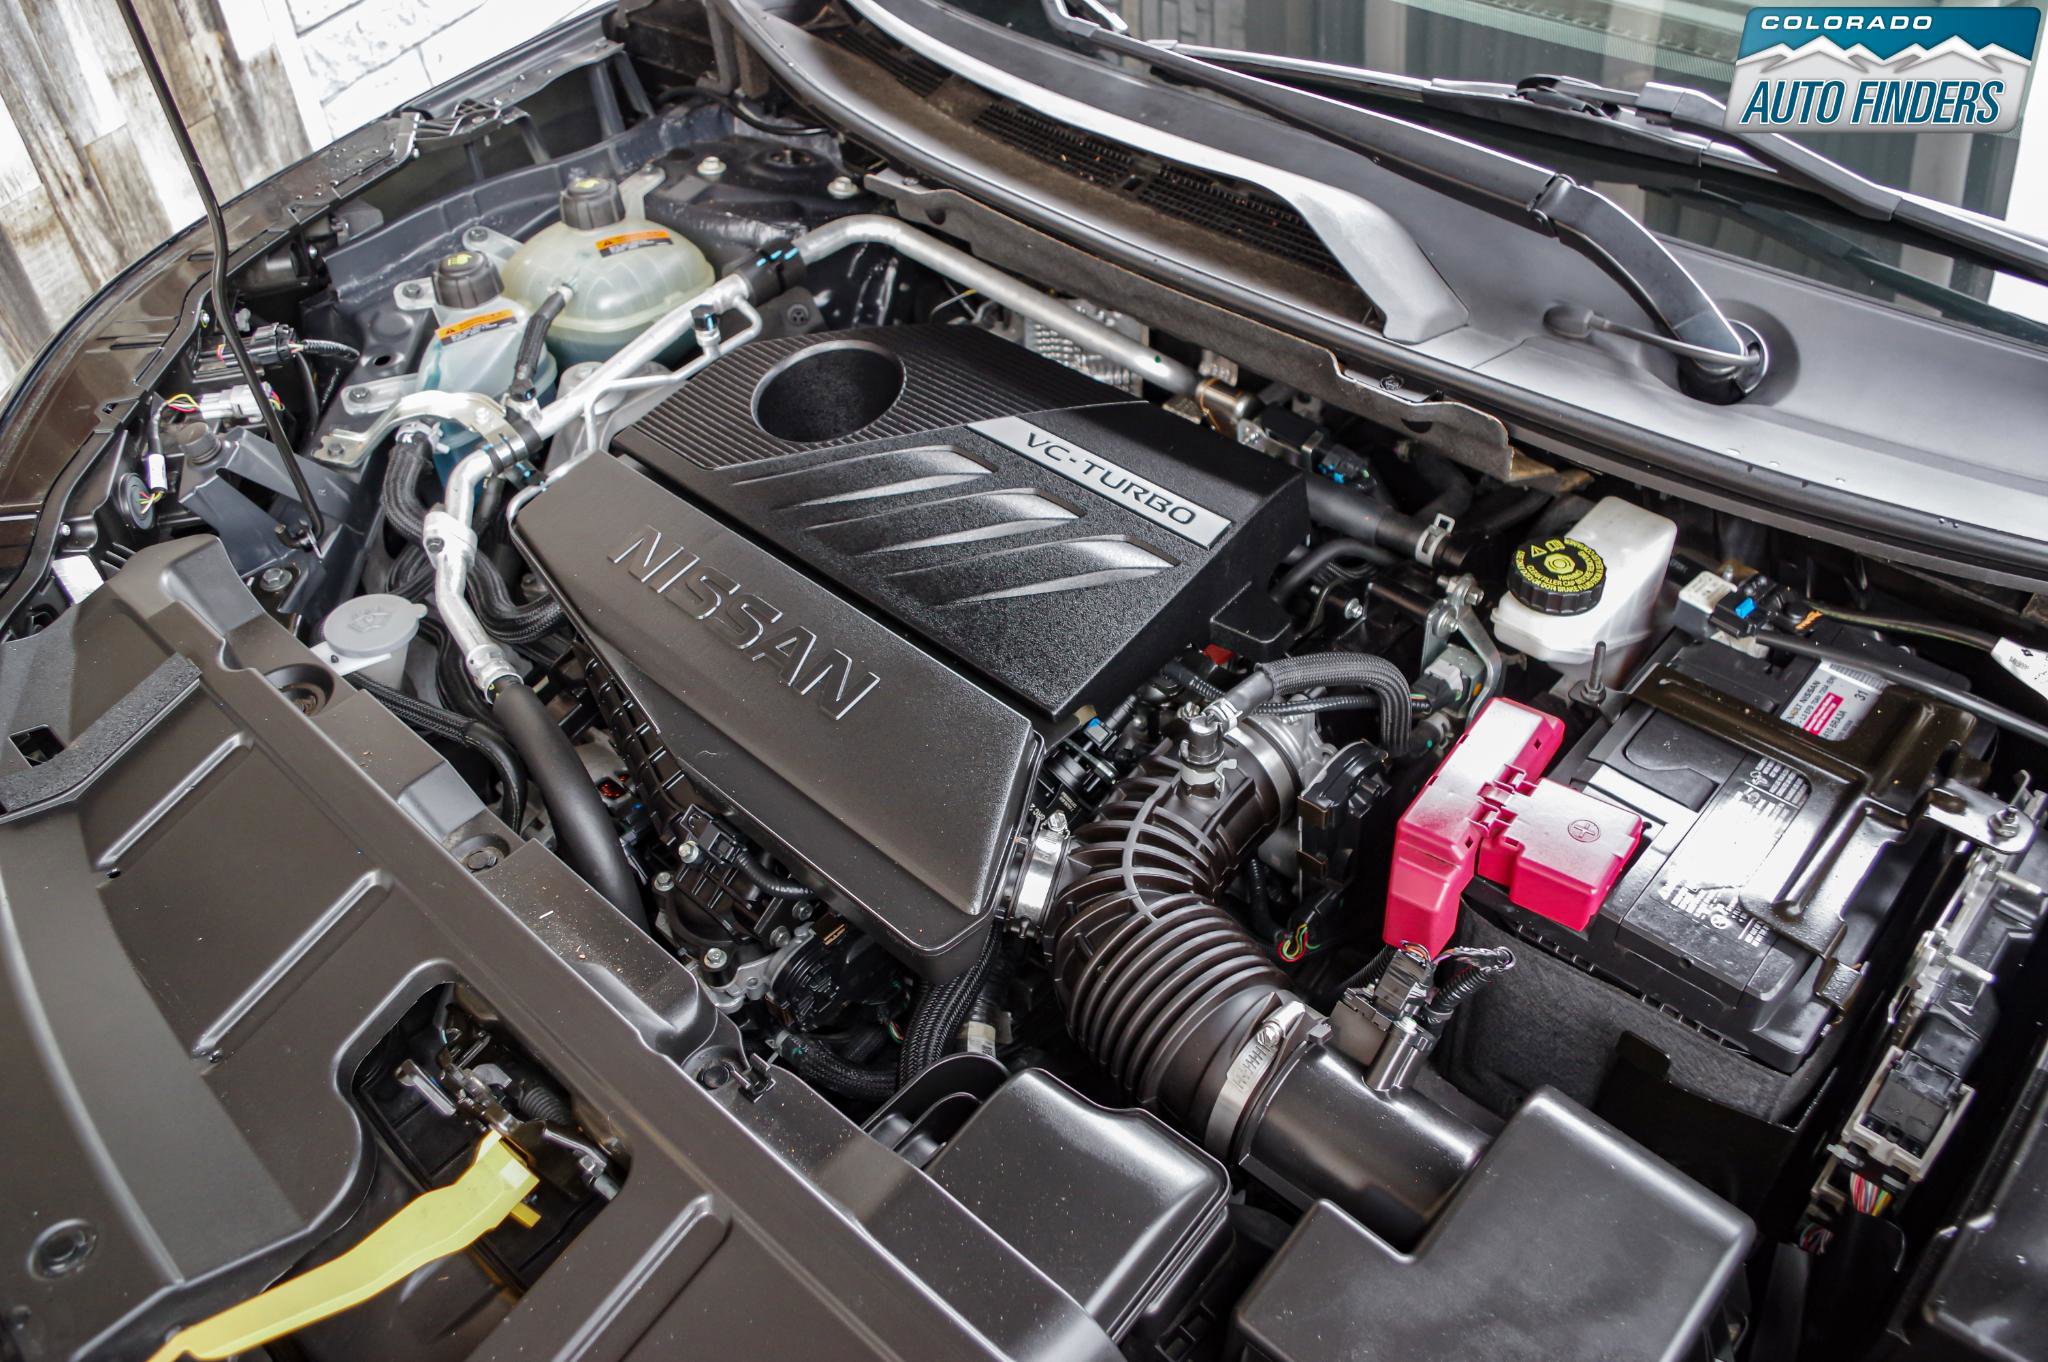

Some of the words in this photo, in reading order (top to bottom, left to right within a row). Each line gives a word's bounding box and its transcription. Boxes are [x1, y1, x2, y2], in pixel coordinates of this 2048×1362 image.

[1025, 432, 1197, 526] VC-TURBO
[1541, 576, 1561, 586] FILLER
[606, 524, 882, 721] NISSAN
[1799, 680, 1821, 704] NISSAN
[1854, 688, 1869, 701] 31
